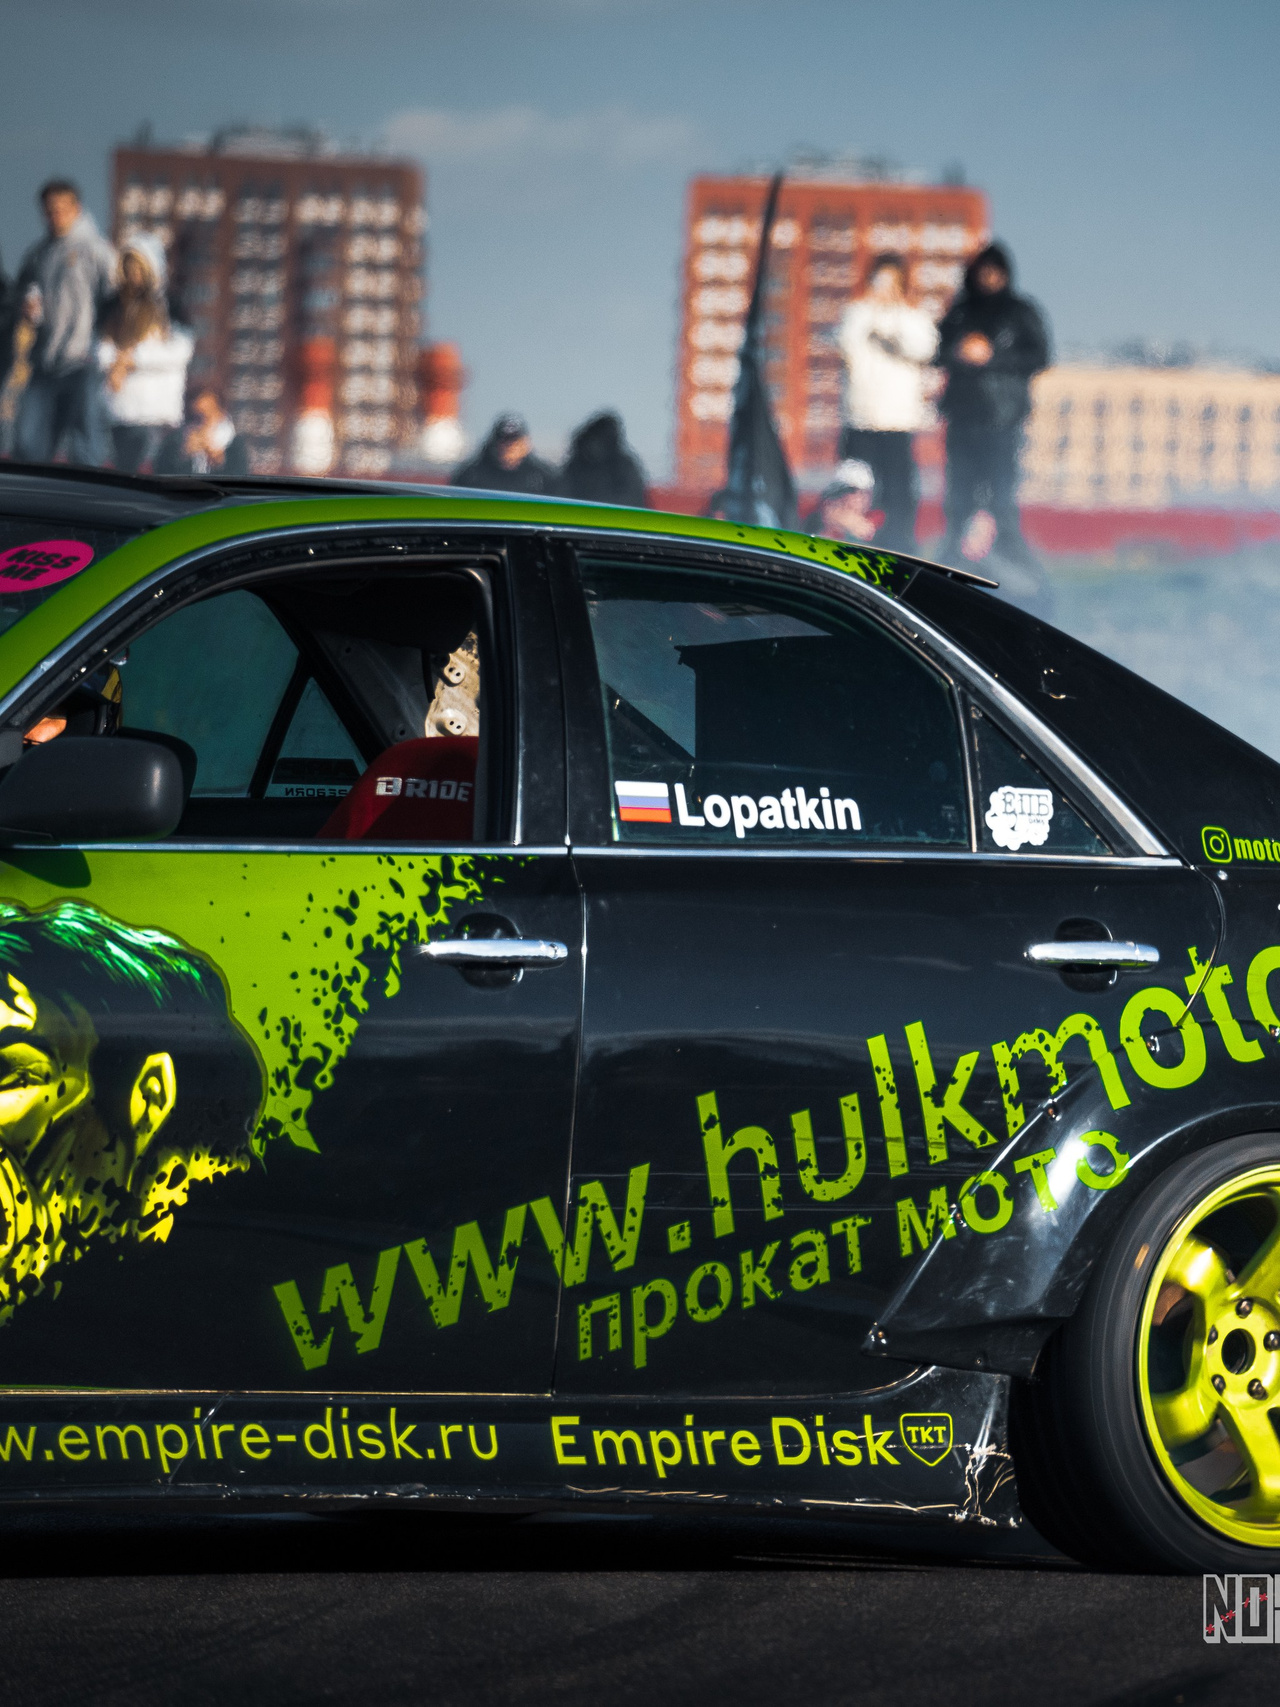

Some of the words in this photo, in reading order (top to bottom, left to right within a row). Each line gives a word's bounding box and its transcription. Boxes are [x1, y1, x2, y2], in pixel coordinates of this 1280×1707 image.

[7, 549, 80, 569] KISS
[0, 564, 50, 581] ME
[376, 777, 473, 802] BRIDE
[674, 783, 861, 838] Lopatkin
[578, 1213, 872, 1369] прокат
[897, 1130, 1131, 1258] мото
[551, 1414, 762, 1478] Empire
[771, 1414, 900, 1466] Disk
[906, 1426, 946, 1445] TKT
